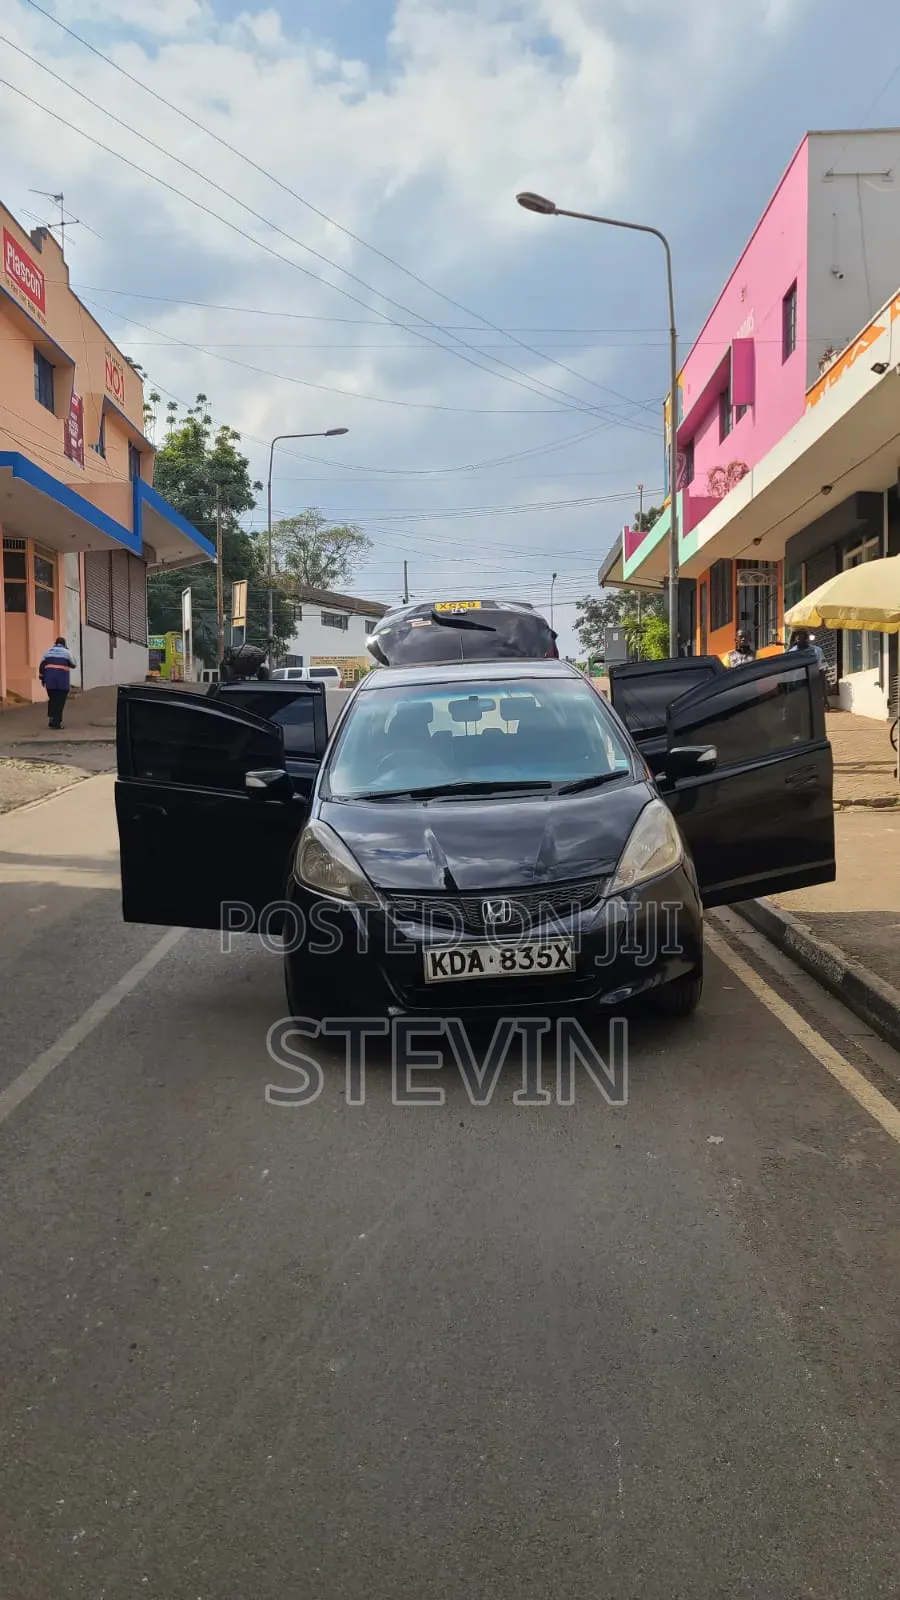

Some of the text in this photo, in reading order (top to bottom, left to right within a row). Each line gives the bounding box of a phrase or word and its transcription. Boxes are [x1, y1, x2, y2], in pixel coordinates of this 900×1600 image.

[6, 241, 41, 300] Plascon
[431, 944, 571, 977] KDA 835X
